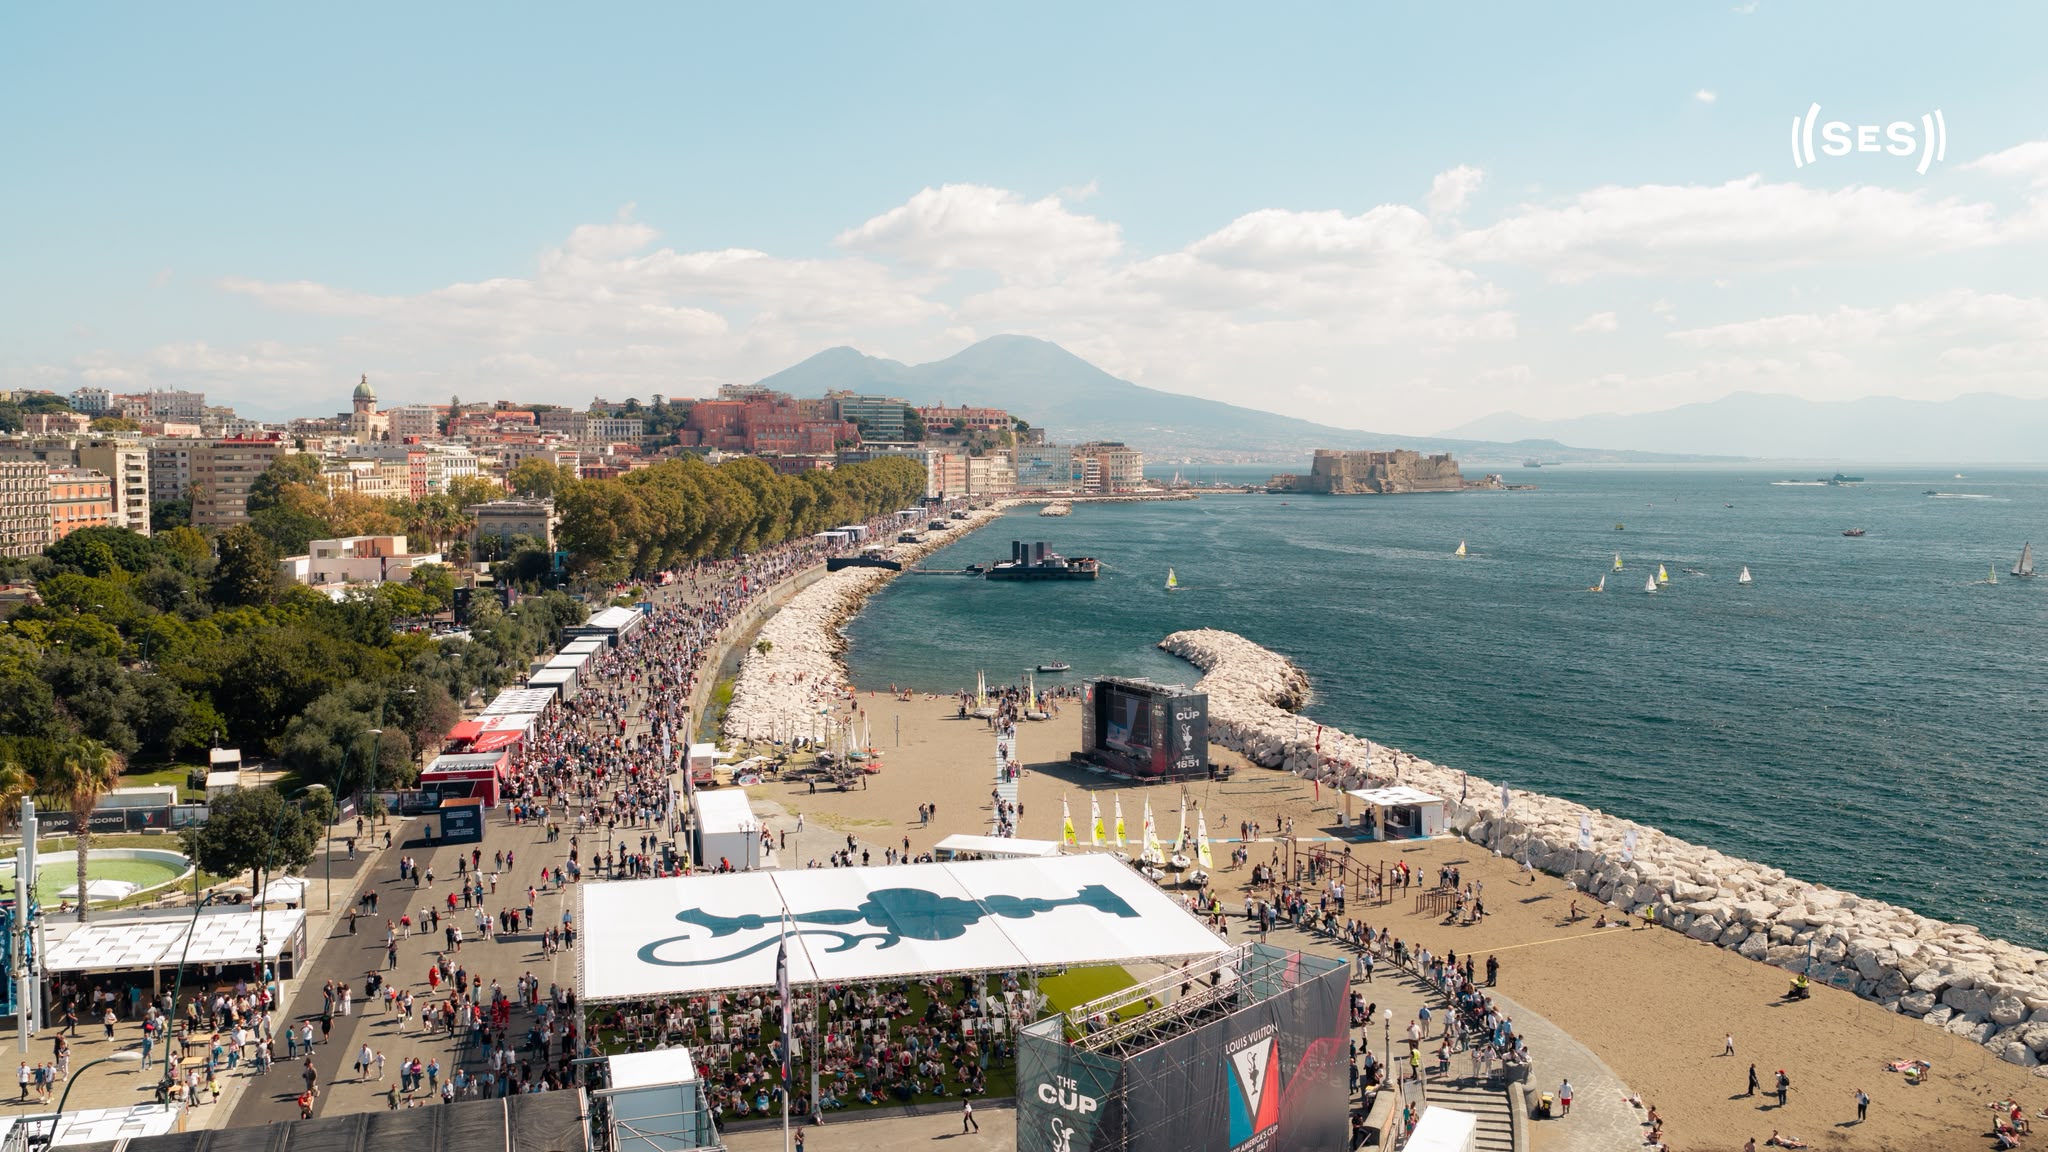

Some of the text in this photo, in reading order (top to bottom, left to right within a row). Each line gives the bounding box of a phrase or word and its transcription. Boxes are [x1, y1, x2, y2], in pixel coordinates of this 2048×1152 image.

[1176, 711, 1200, 720] CUP
[1176, 759, 1199, 768] 1851
[88, 816, 123, 824] ECOND
[1225, 1021, 1278, 1055] LOUIS VUITTON
[1056, 1075, 1078, 1091] THE
[1038, 1083, 1097, 1114] CUP
[1241, 1124, 1279, 1152] AMERICA'S CUP
